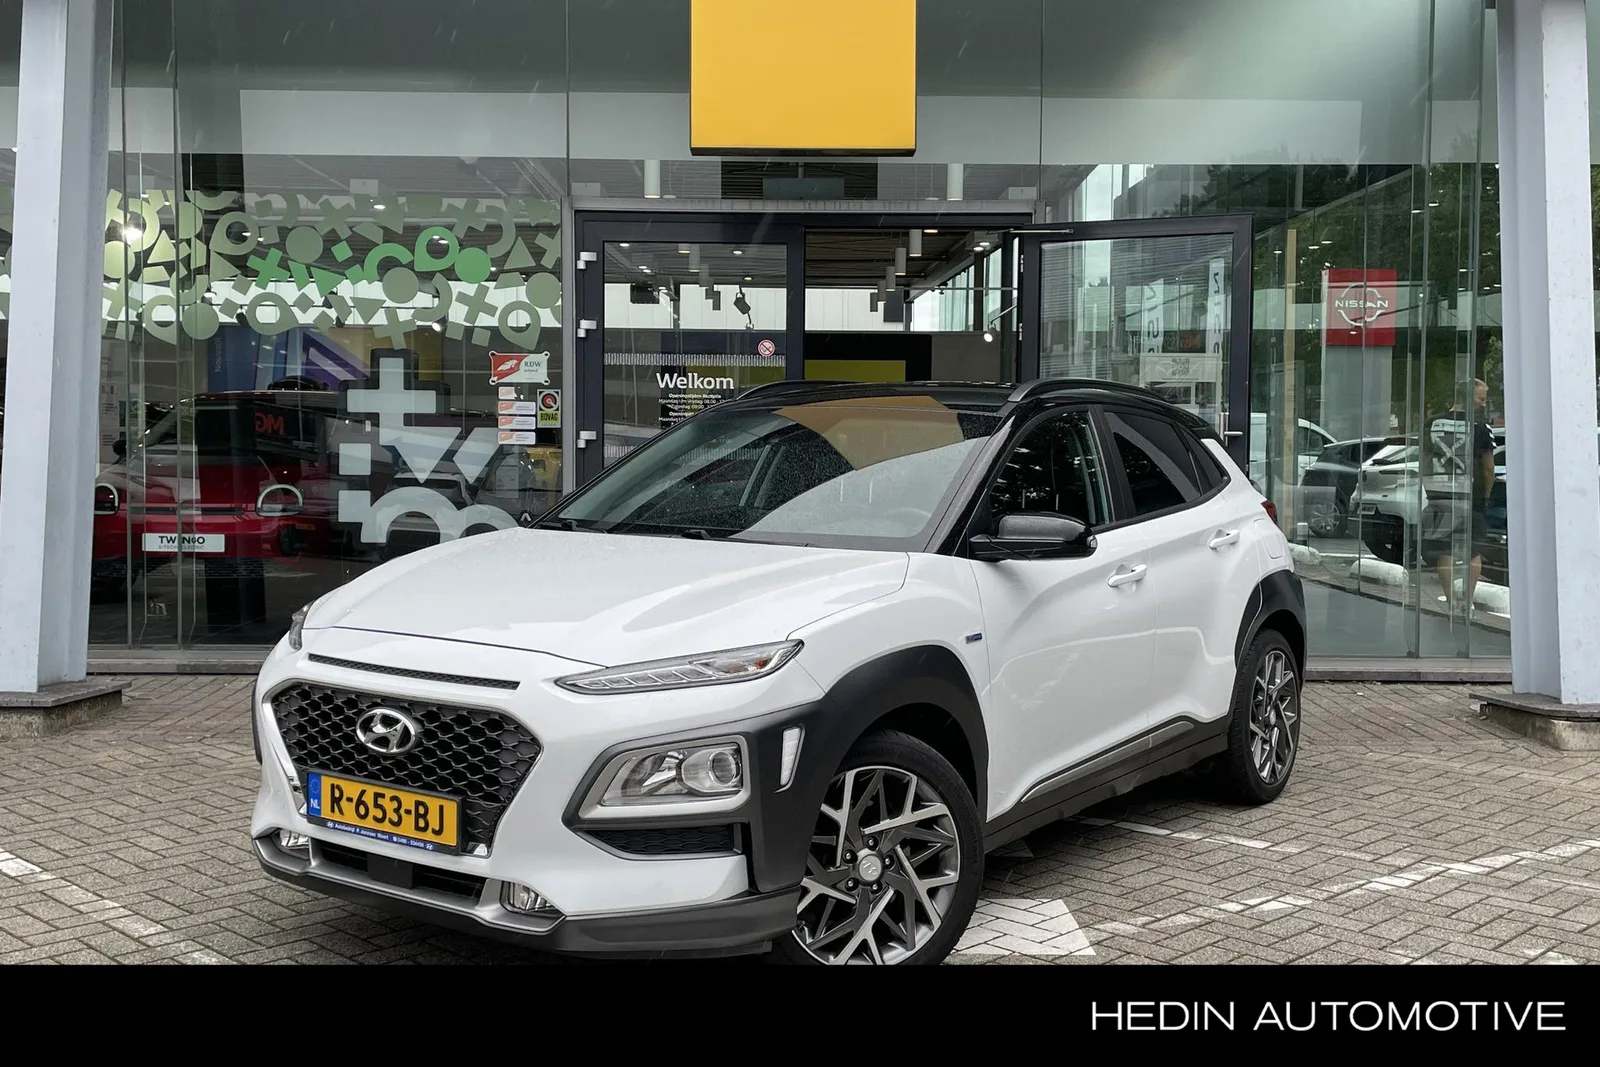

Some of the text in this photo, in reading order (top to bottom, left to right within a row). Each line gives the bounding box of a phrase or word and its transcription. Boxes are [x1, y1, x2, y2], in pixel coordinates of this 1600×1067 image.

[1335, 300, 1388, 308] NISSAN
[656, 373, 734, 389] Welkom
[540, 413, 558, 421] BOVAG
[158, 536, 206, 545] TWNGO
[310, 798, 320, 809] NL
[330, 783, 444, 836] R-653-BJ
